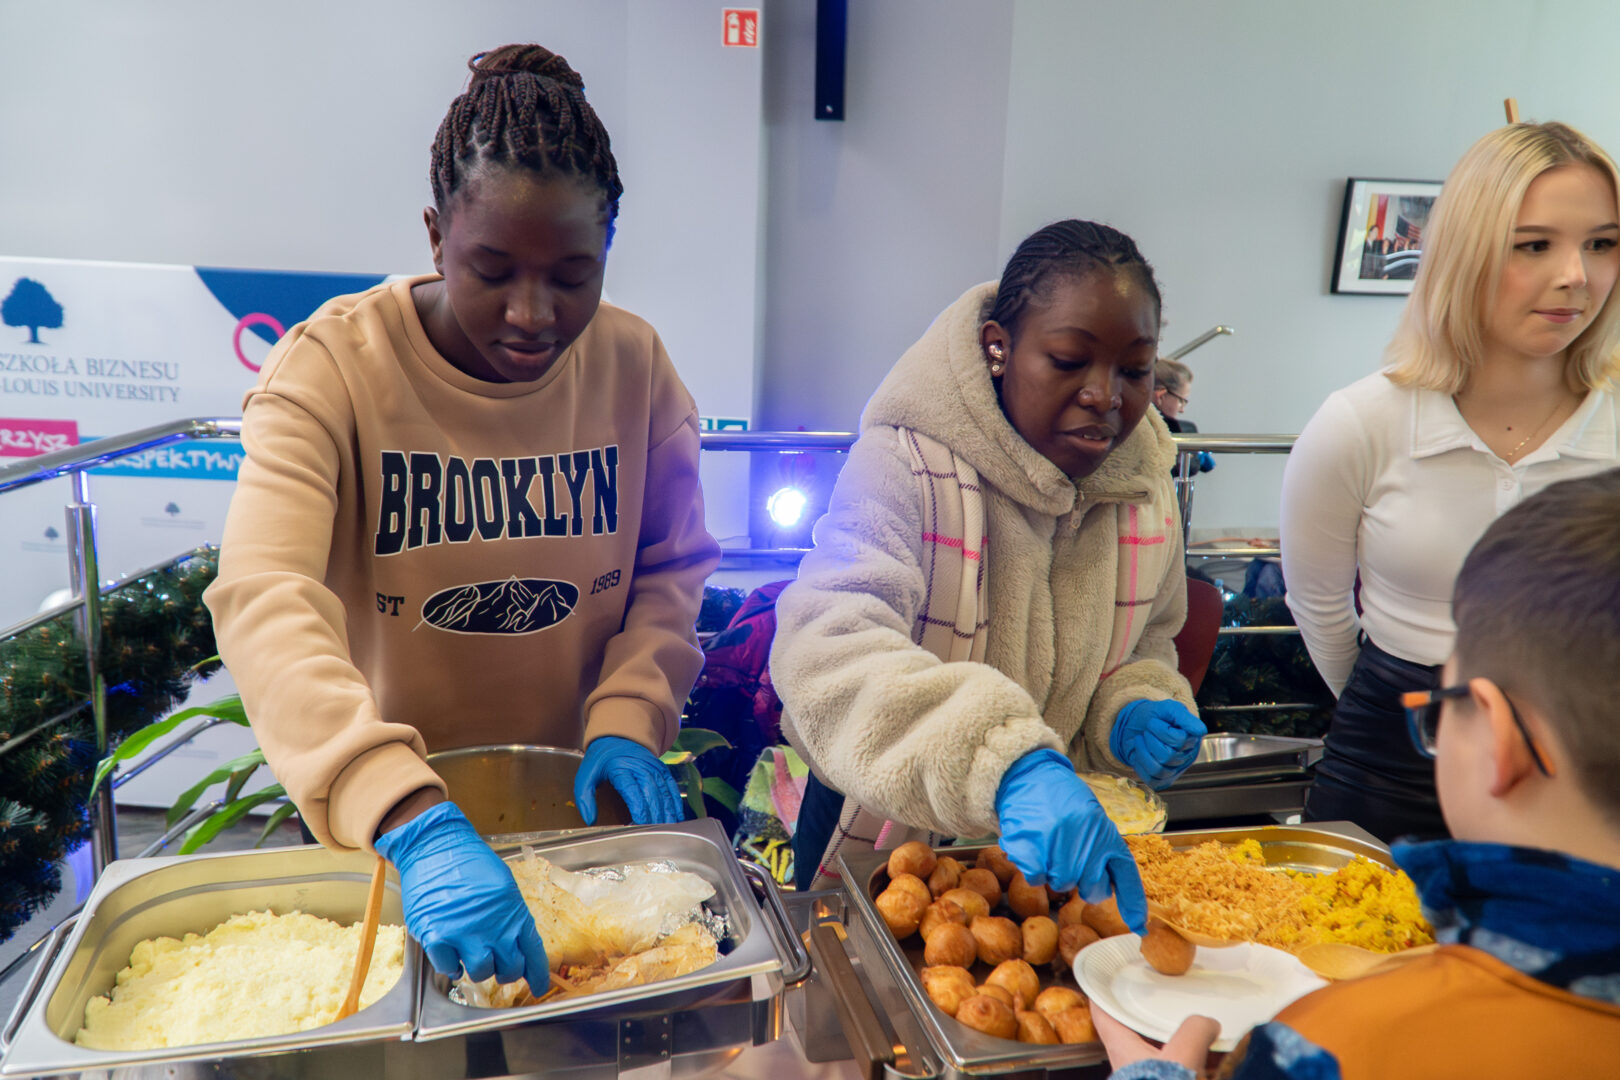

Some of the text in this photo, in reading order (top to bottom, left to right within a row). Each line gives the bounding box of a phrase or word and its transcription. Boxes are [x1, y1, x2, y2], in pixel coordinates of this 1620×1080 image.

[86, 358, 180, 380] BIZNESU
[64, 380, 181, 402] UNIVERSITY
[0, 429, 70, 452] RZYSZ
[374, 444, 618, 556] BROOKLYN
[375, 568, 622, 617] ST 1989
